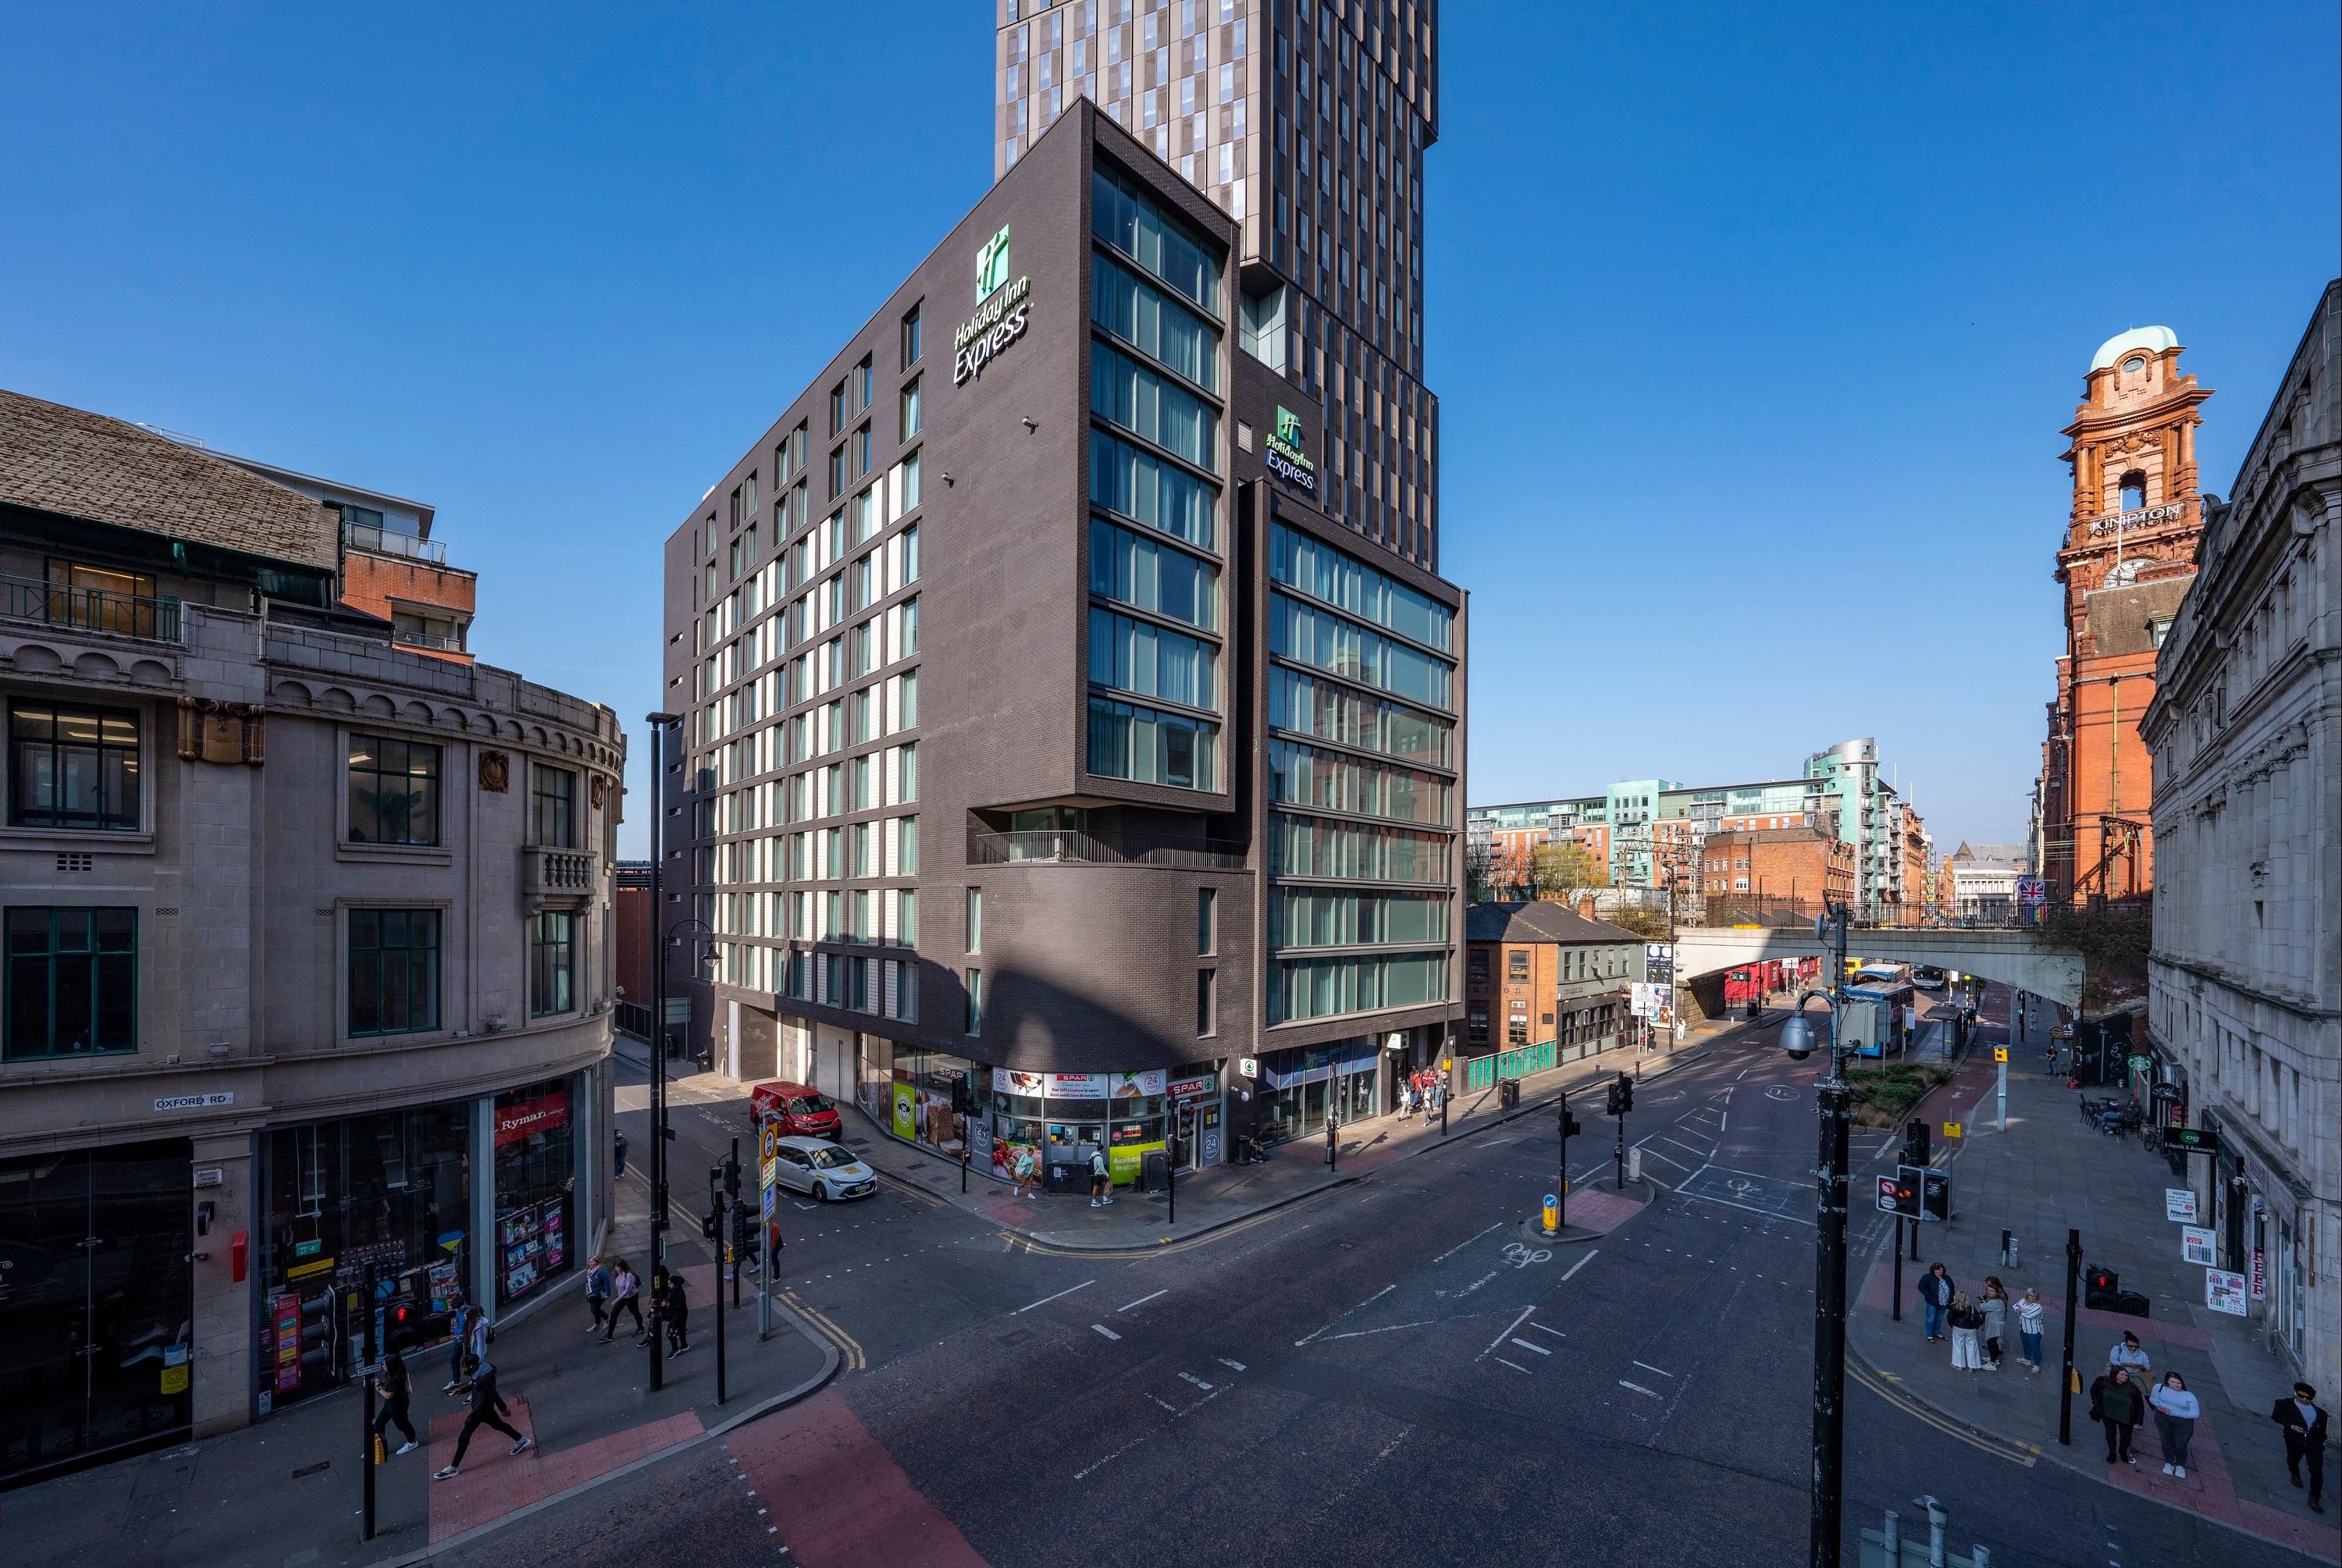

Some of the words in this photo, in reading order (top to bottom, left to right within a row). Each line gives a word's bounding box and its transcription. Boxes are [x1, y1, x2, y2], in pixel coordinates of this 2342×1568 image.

[954, 297, 1003, 351] Holiday
[1004, 276, 1029, 308] Inn
[954, 304, 1027, 384] Express
[1266, 433, 1300, 465] Holiday
[1300, 453, 1314, 471] Inn
[1266, 448, 1314, 489] Express
[2091, 505, 2180, 531] KIMPTON
[998, 1073, 1006, 1082] 24
[1148, 1076, 1158, 1085] 24
[1173, 1080, 1203, 1094] SPAR
[156, 1097, 205, 1108] OXFORD
[210, 1095, 226, 1104] RD
[500, 1111, 547, 1131] Ryman
[1205, 1138, 1216, 1149] 24
[2190, 1145, 2216, 1154] Accessories
